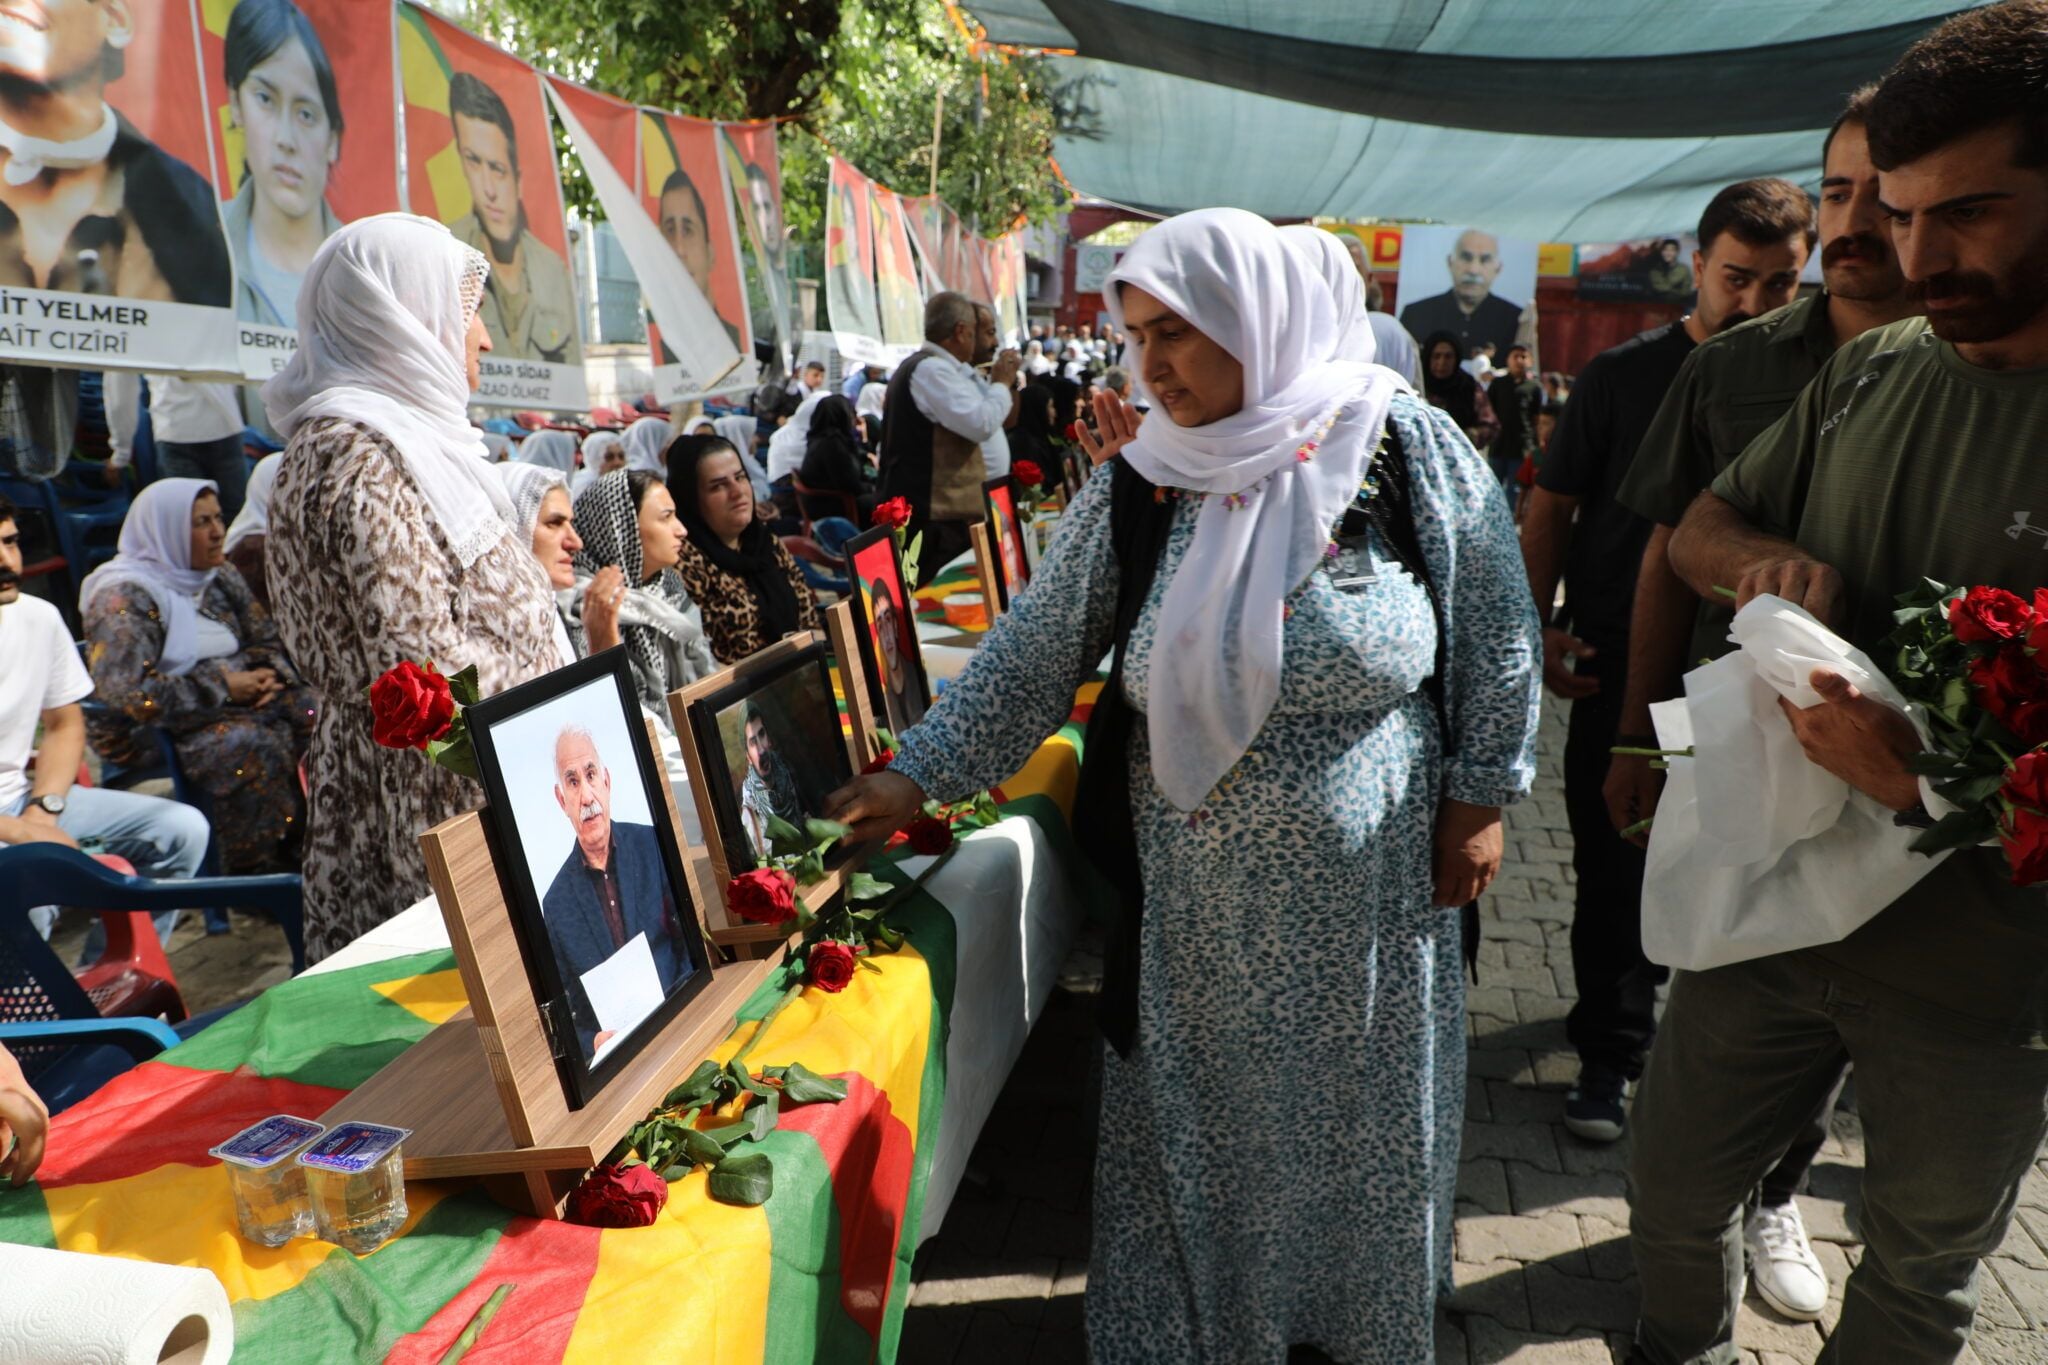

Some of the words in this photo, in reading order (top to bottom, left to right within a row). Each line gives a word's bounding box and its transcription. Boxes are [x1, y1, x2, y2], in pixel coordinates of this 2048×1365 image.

[0, 289, 28, 316] İT
[37, 298, 148, 326] YELMER
[241, 330, 298, 350] DERYA
